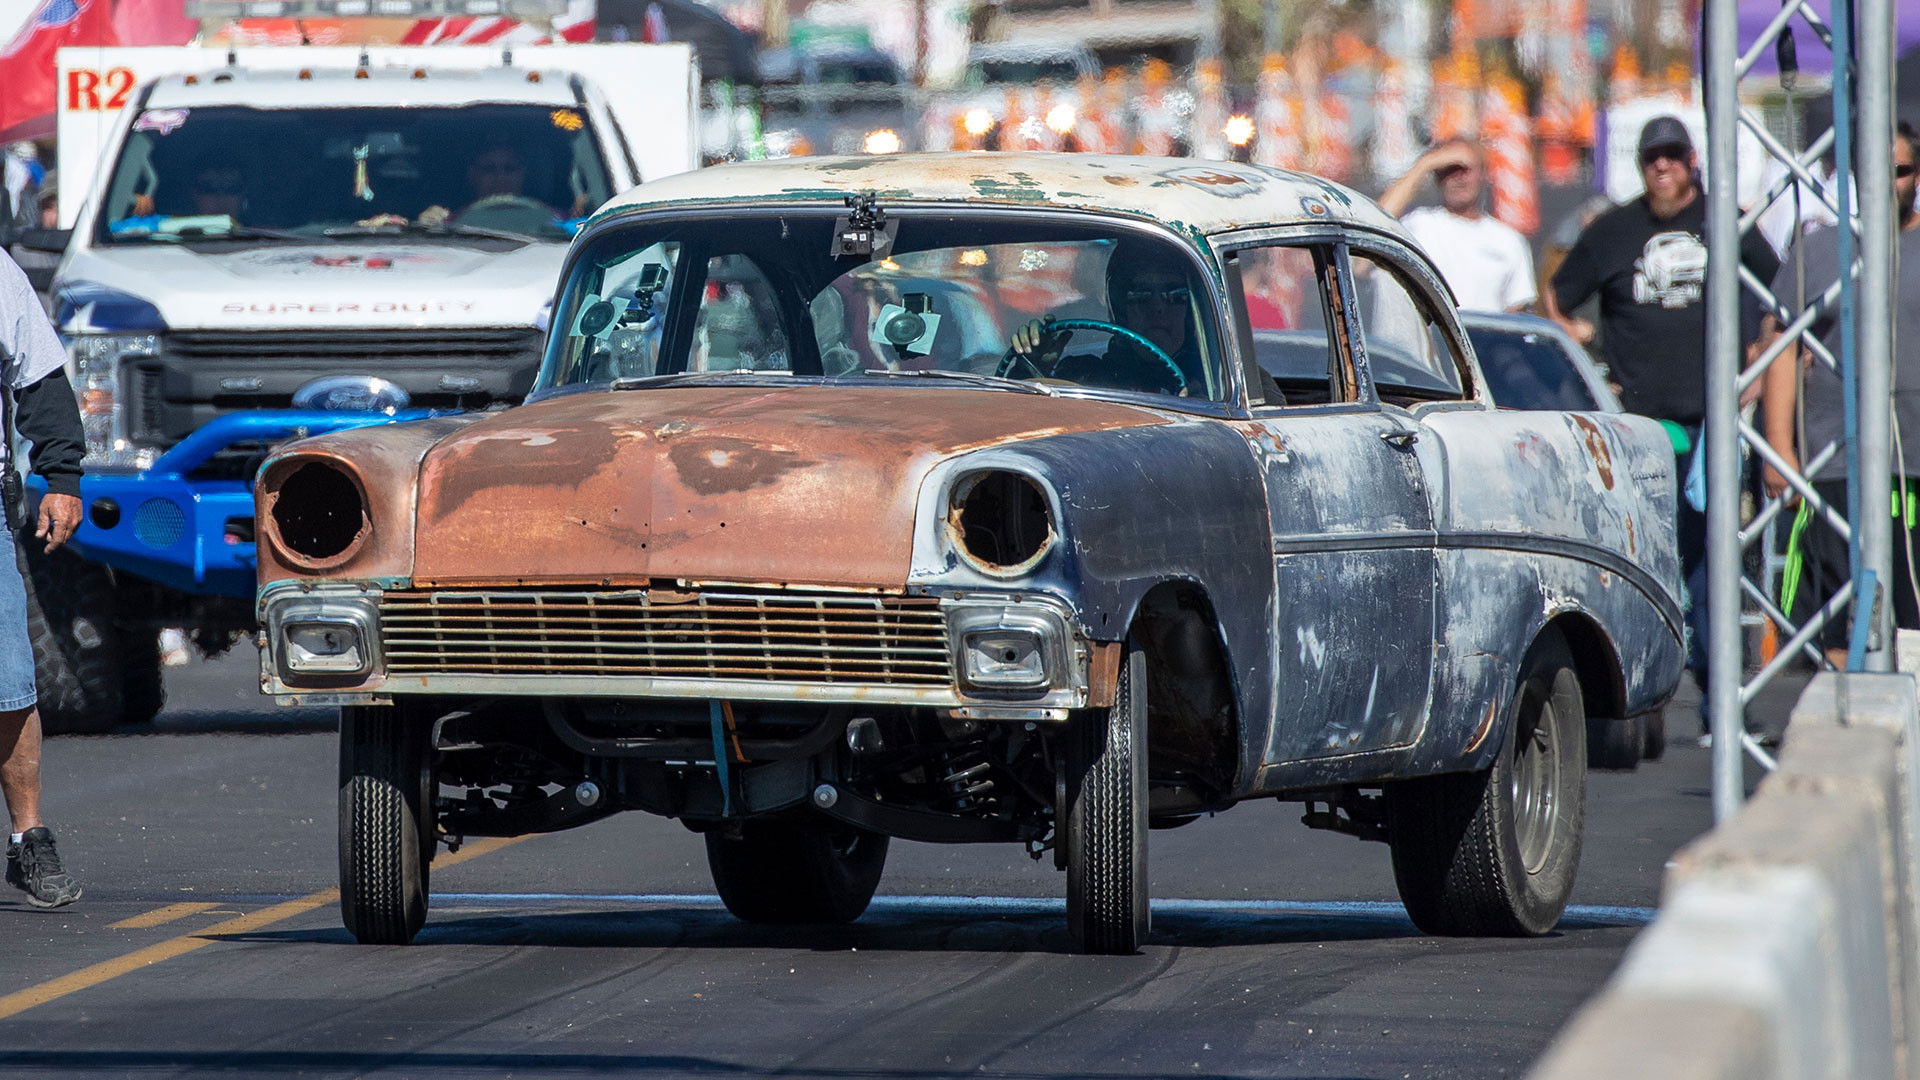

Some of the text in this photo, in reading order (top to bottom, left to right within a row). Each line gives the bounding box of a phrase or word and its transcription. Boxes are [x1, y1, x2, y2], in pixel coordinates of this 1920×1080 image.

[67, 67, 136, 111] R2
[222, 302, 475, 313] SUPER DUTY
